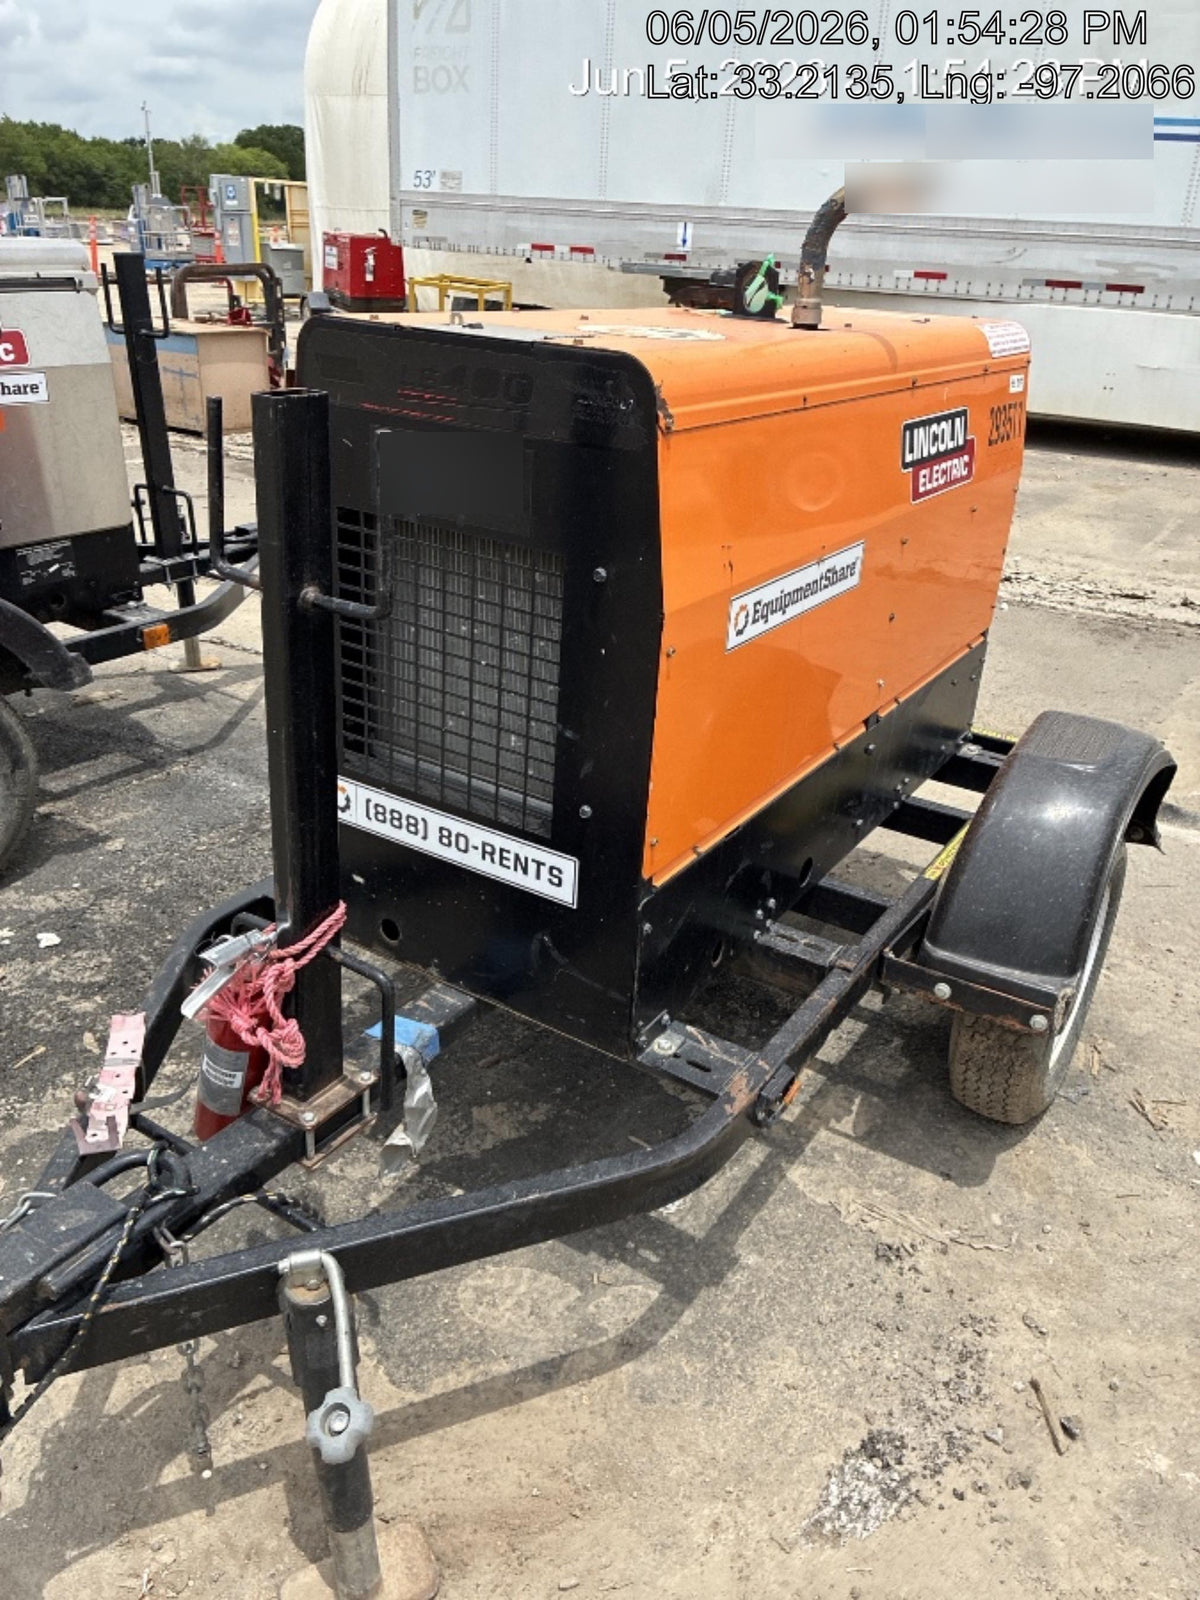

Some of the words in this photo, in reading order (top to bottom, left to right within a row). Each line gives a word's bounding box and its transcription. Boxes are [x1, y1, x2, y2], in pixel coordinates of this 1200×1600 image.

[413, 65, 471, 95] BOX
[413, 170, 436, 189] 53'
[905, 415, 965, 463] LINCOLN
[918, 454, 970, 493] ELECTRIC
[751, 560, 857, 625] EquipmentShare
[364, 797, 430, 841] (888)
[438, 826, 564, 889] 80-RENTS
